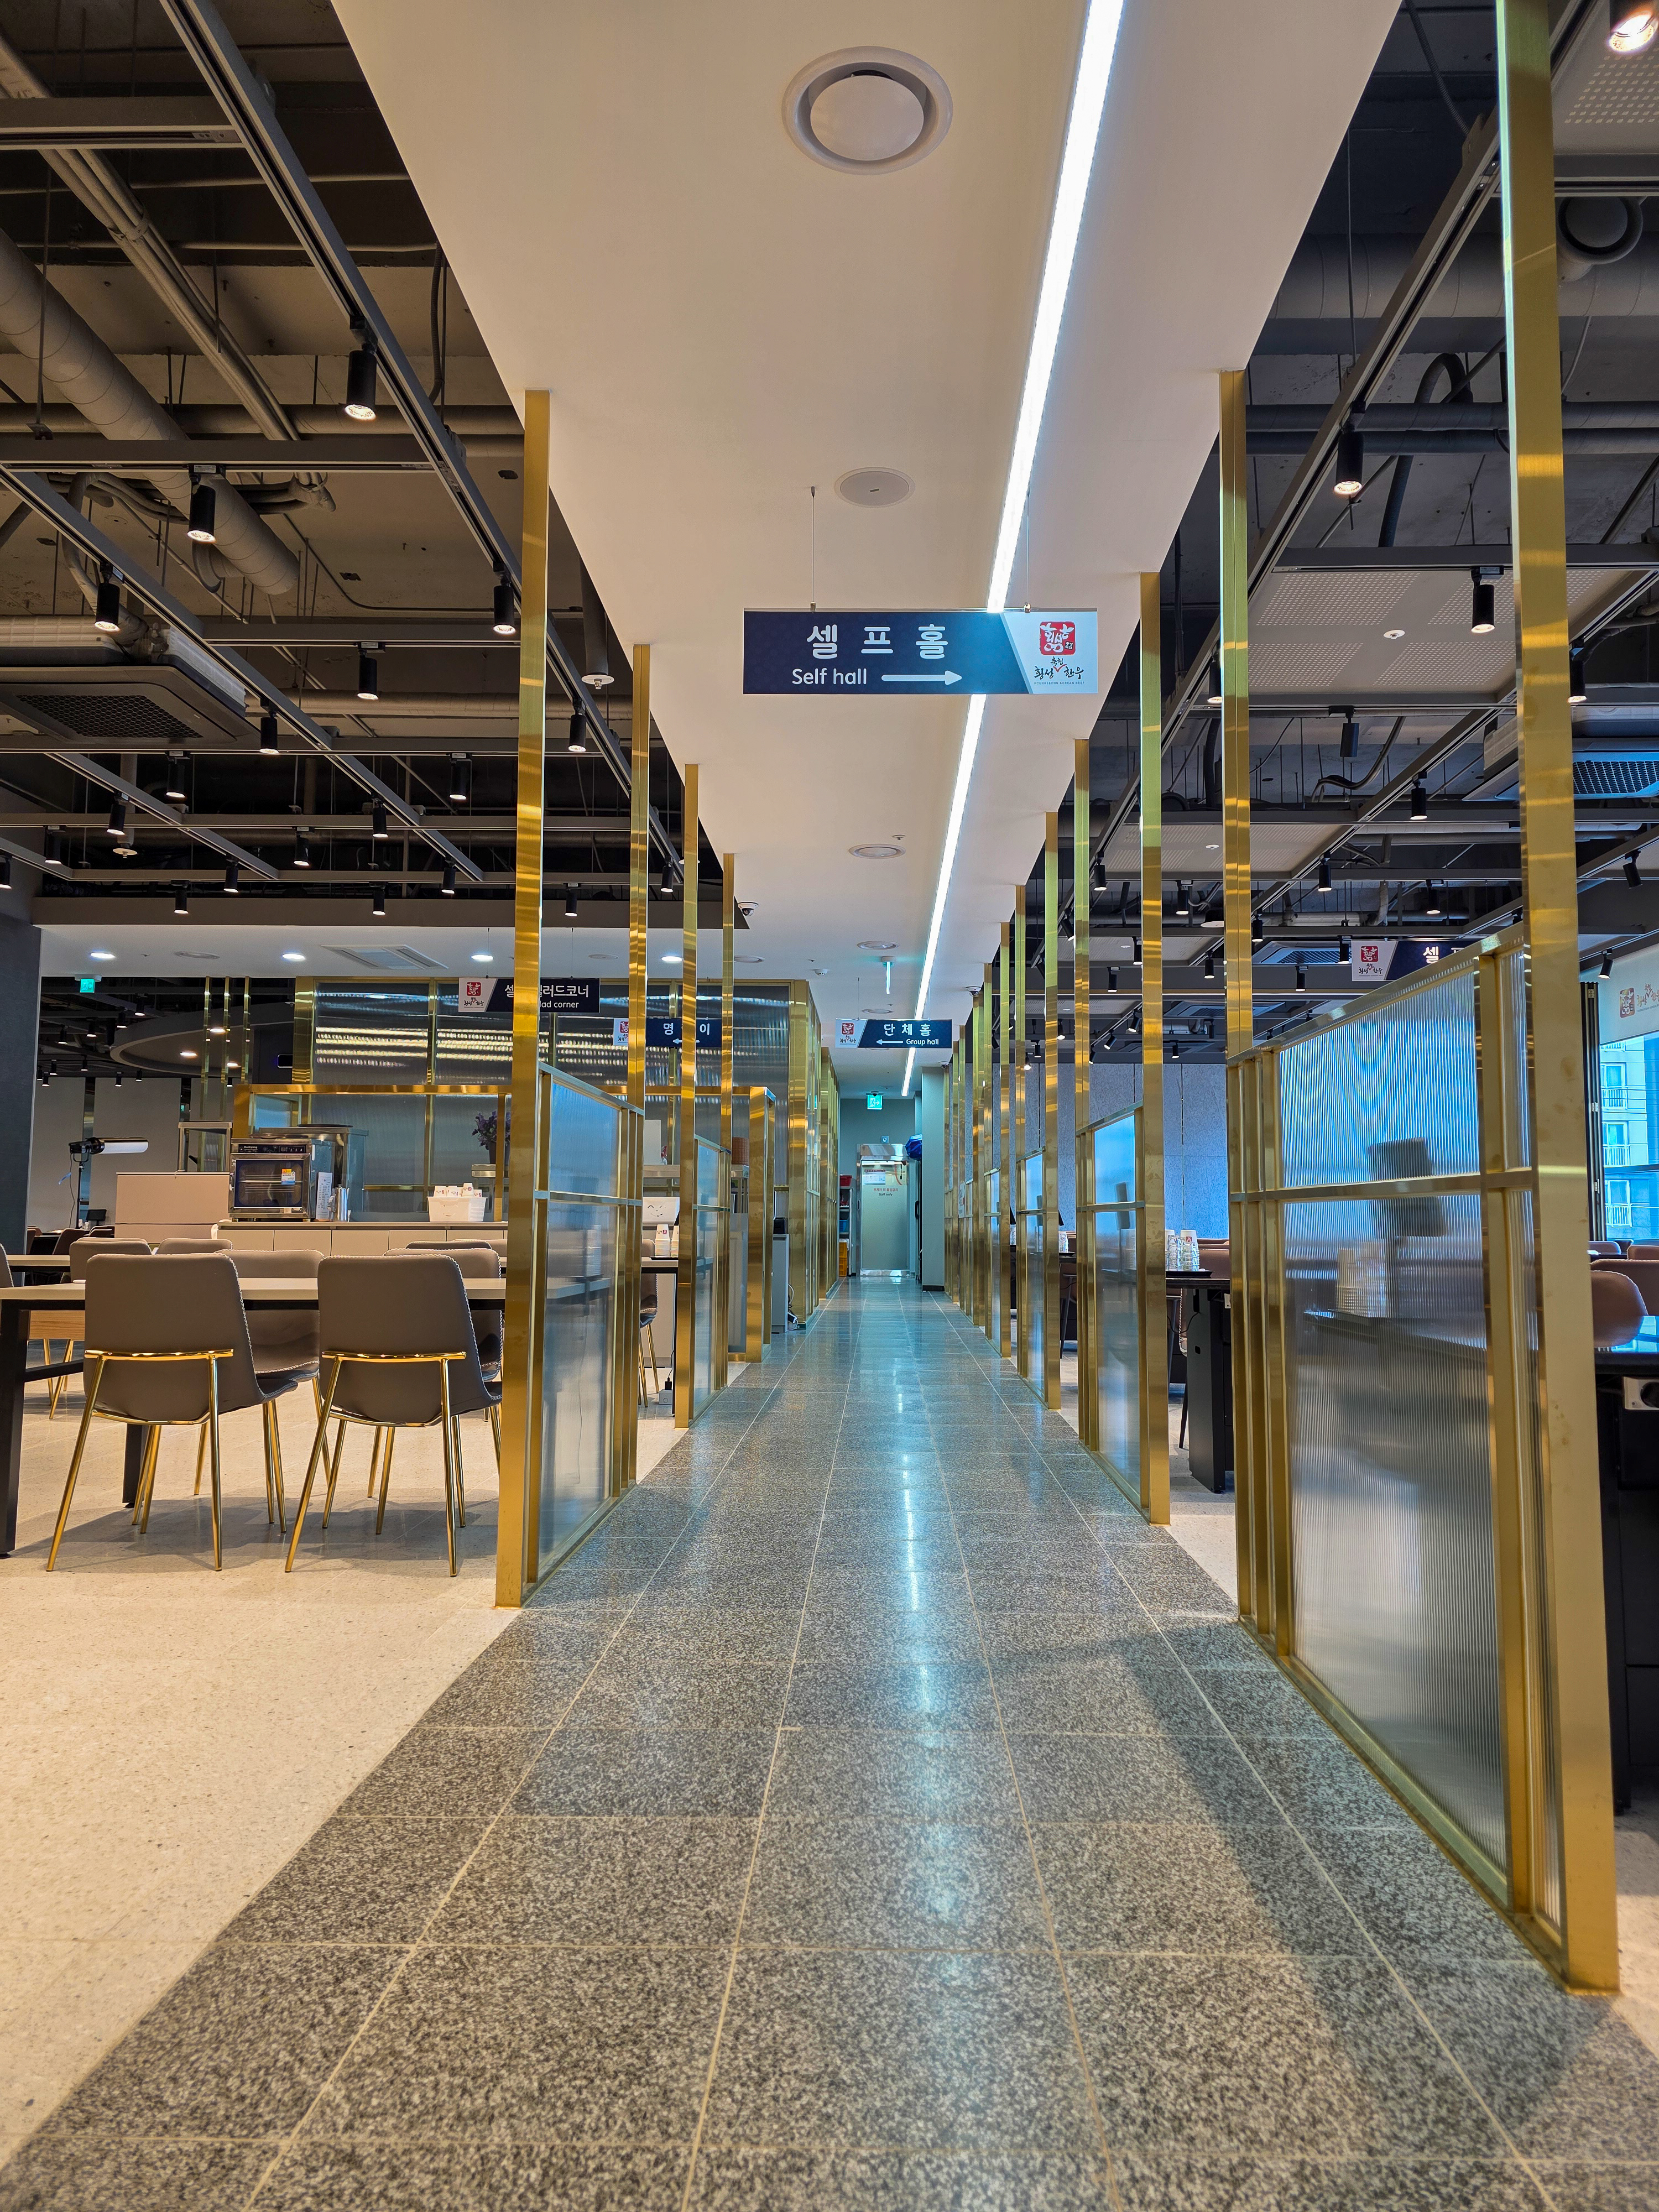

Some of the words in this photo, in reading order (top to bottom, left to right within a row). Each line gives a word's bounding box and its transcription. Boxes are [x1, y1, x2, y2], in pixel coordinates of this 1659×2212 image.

[792, 668, 827, 685] Self
[833, 668, 867, 685] hall
[906, 1038, 926, 1046] Group
